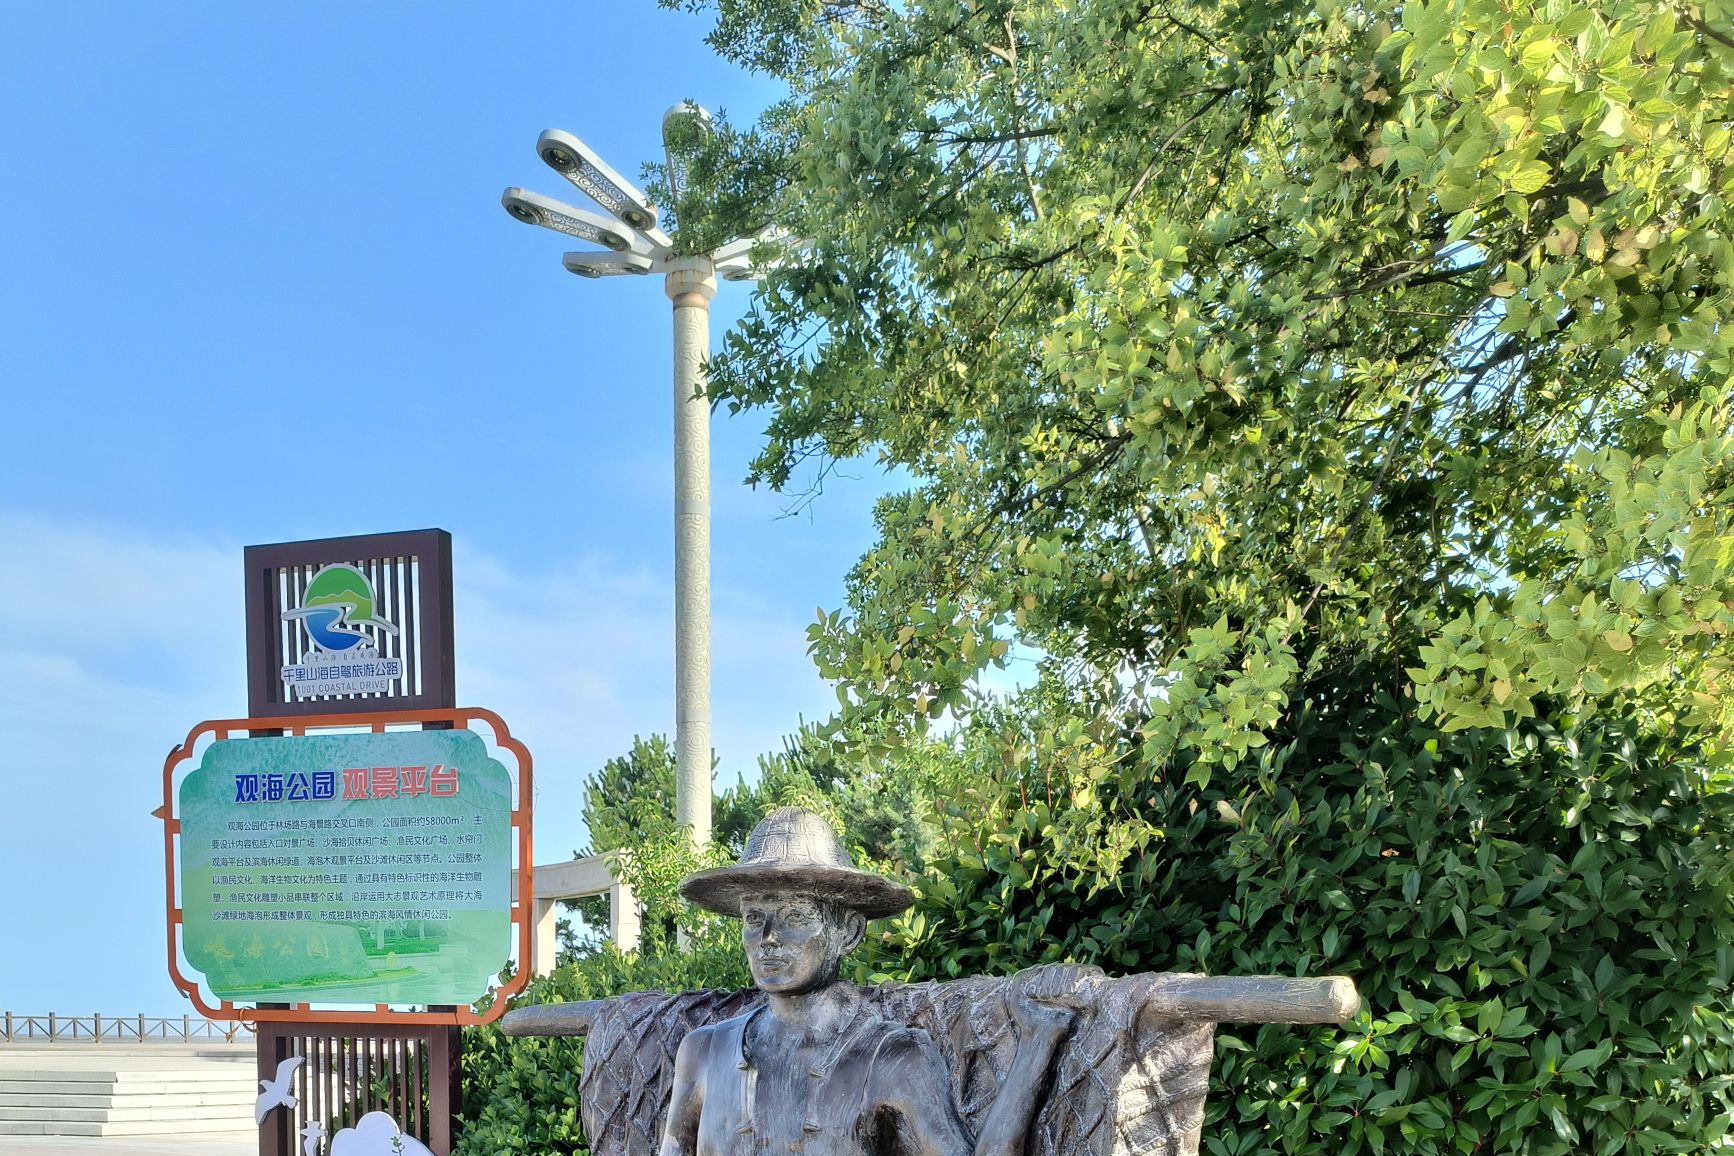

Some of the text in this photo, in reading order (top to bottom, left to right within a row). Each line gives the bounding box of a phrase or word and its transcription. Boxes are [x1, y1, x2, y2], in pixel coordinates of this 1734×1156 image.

[283, 661, 398, 682] 千里山海自驾旅游公路
[297, 680, 385, 694] 1001 COASTAL DRIVE
[235, 764, 459, 803] 观海公园 观景平台
